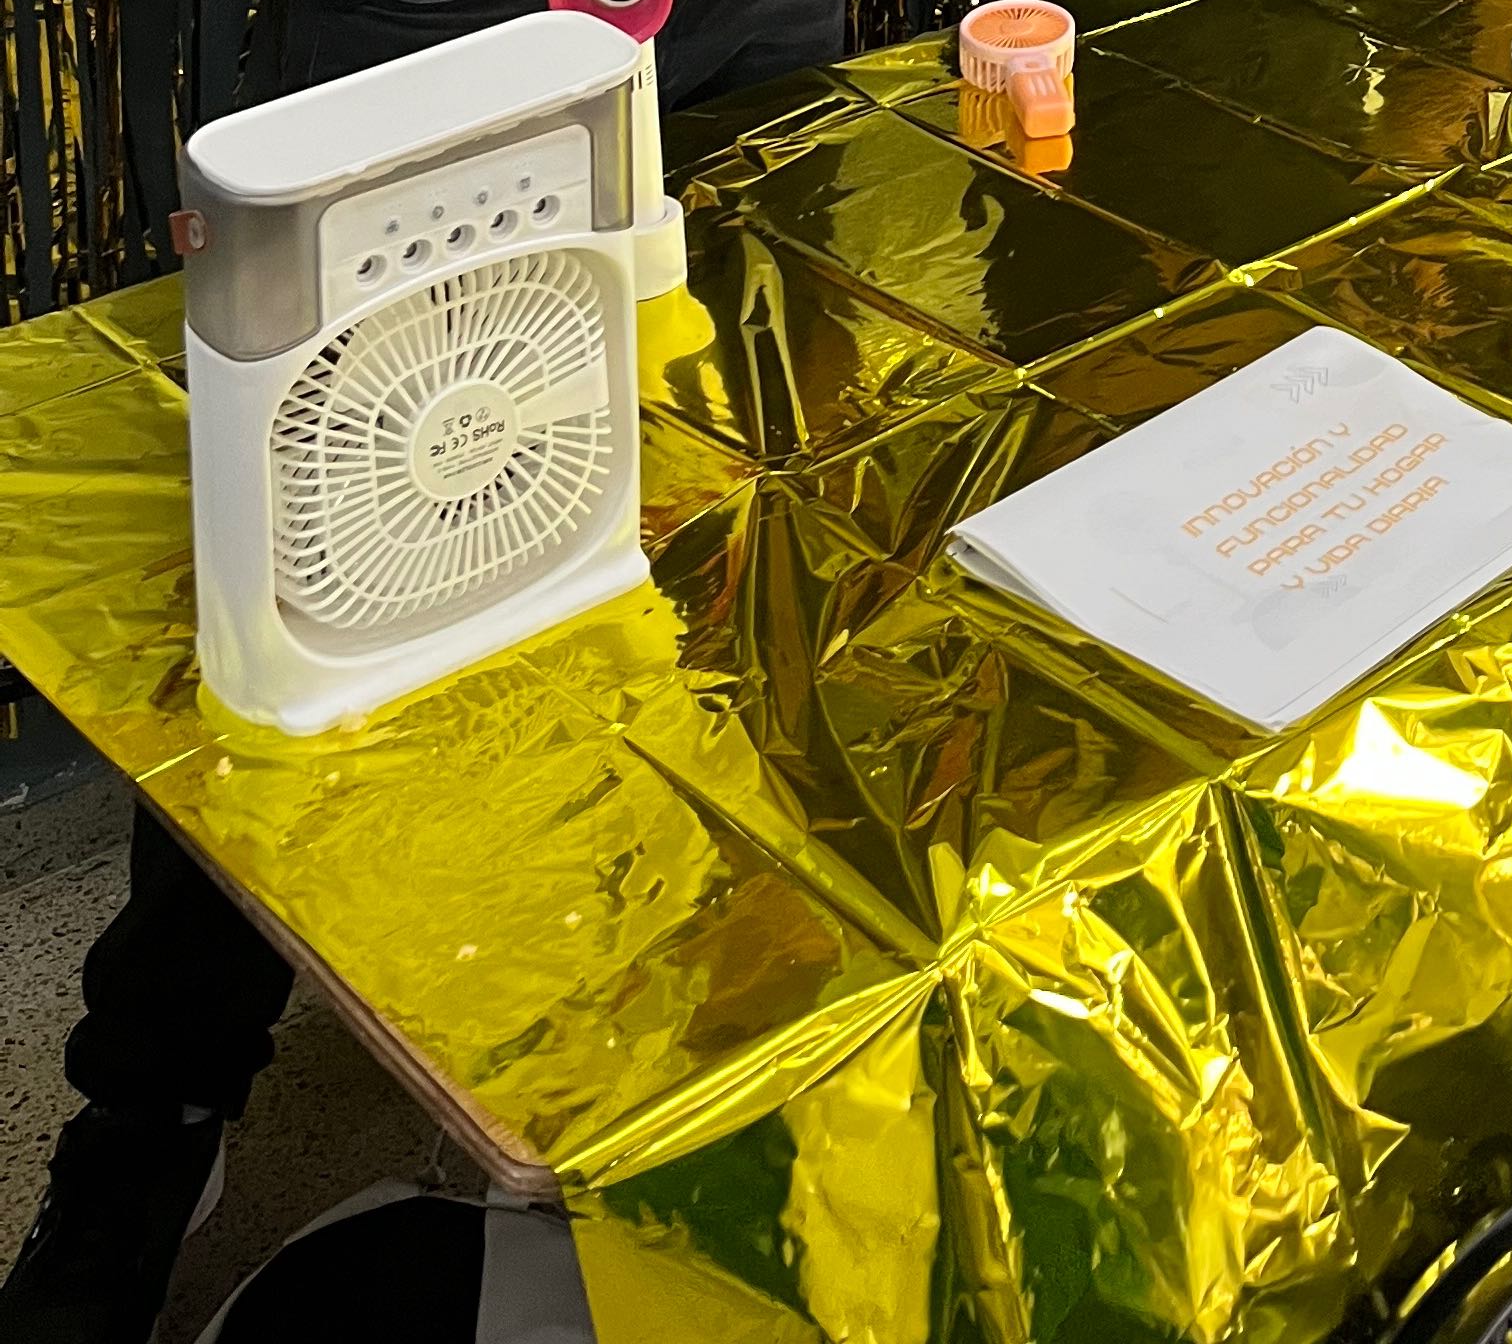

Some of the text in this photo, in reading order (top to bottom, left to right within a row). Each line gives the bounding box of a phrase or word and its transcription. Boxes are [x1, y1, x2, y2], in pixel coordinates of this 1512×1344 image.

[1247, 432, 1451, 577] PARA TU HOGAR
[1304, 533, 1372, 575] VIDA
[1366, 475, 1451, 535] DIARIA
